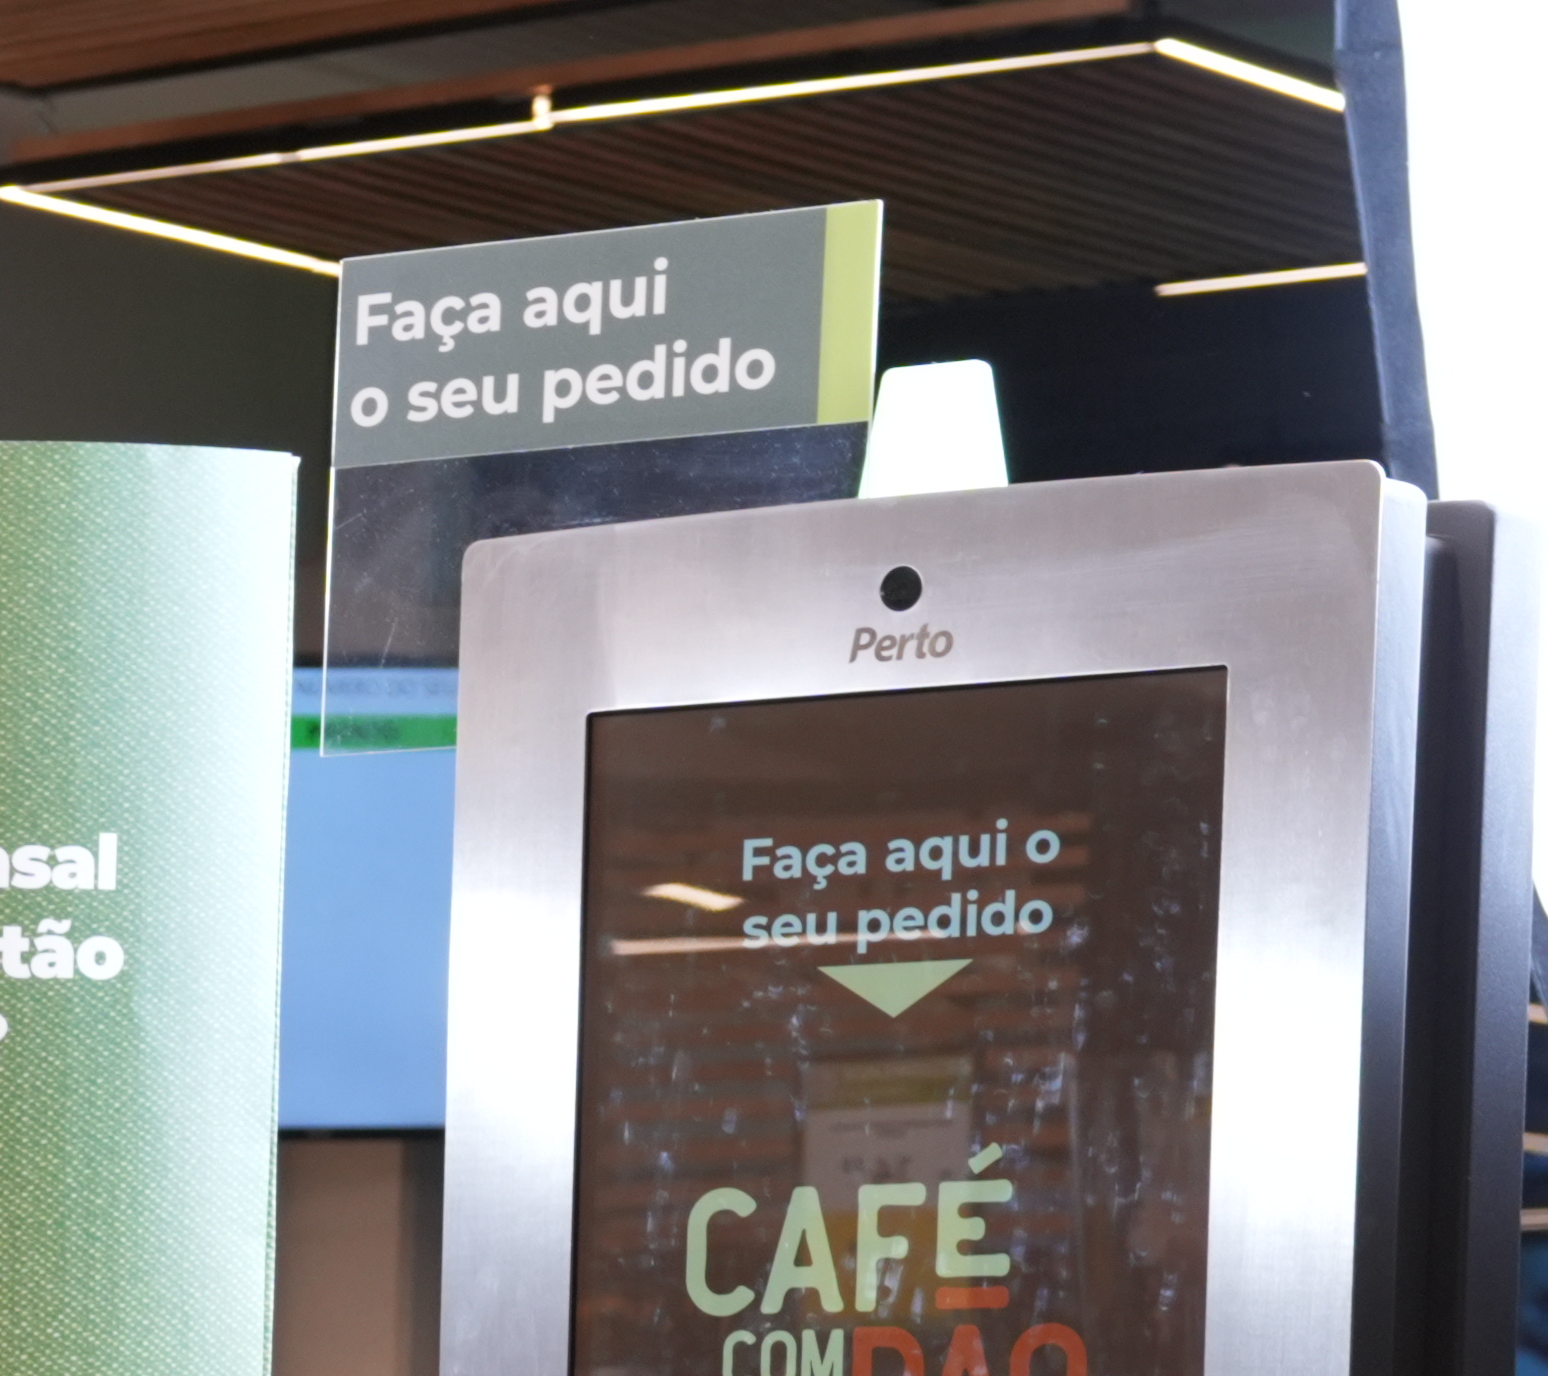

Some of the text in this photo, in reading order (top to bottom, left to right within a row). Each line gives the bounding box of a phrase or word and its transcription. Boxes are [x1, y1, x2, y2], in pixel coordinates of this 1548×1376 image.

[353, 257, 669, 354] Faça aqui
[351, 337, 776, 429] o seu pedido
[848, 625, 954, 665] Perto
[741, 817, 1061, 889] Faça aqui o
[741, 890, 1053, 954] seu pedido
[685, 1142, 1013, 1317] CAFÉ
